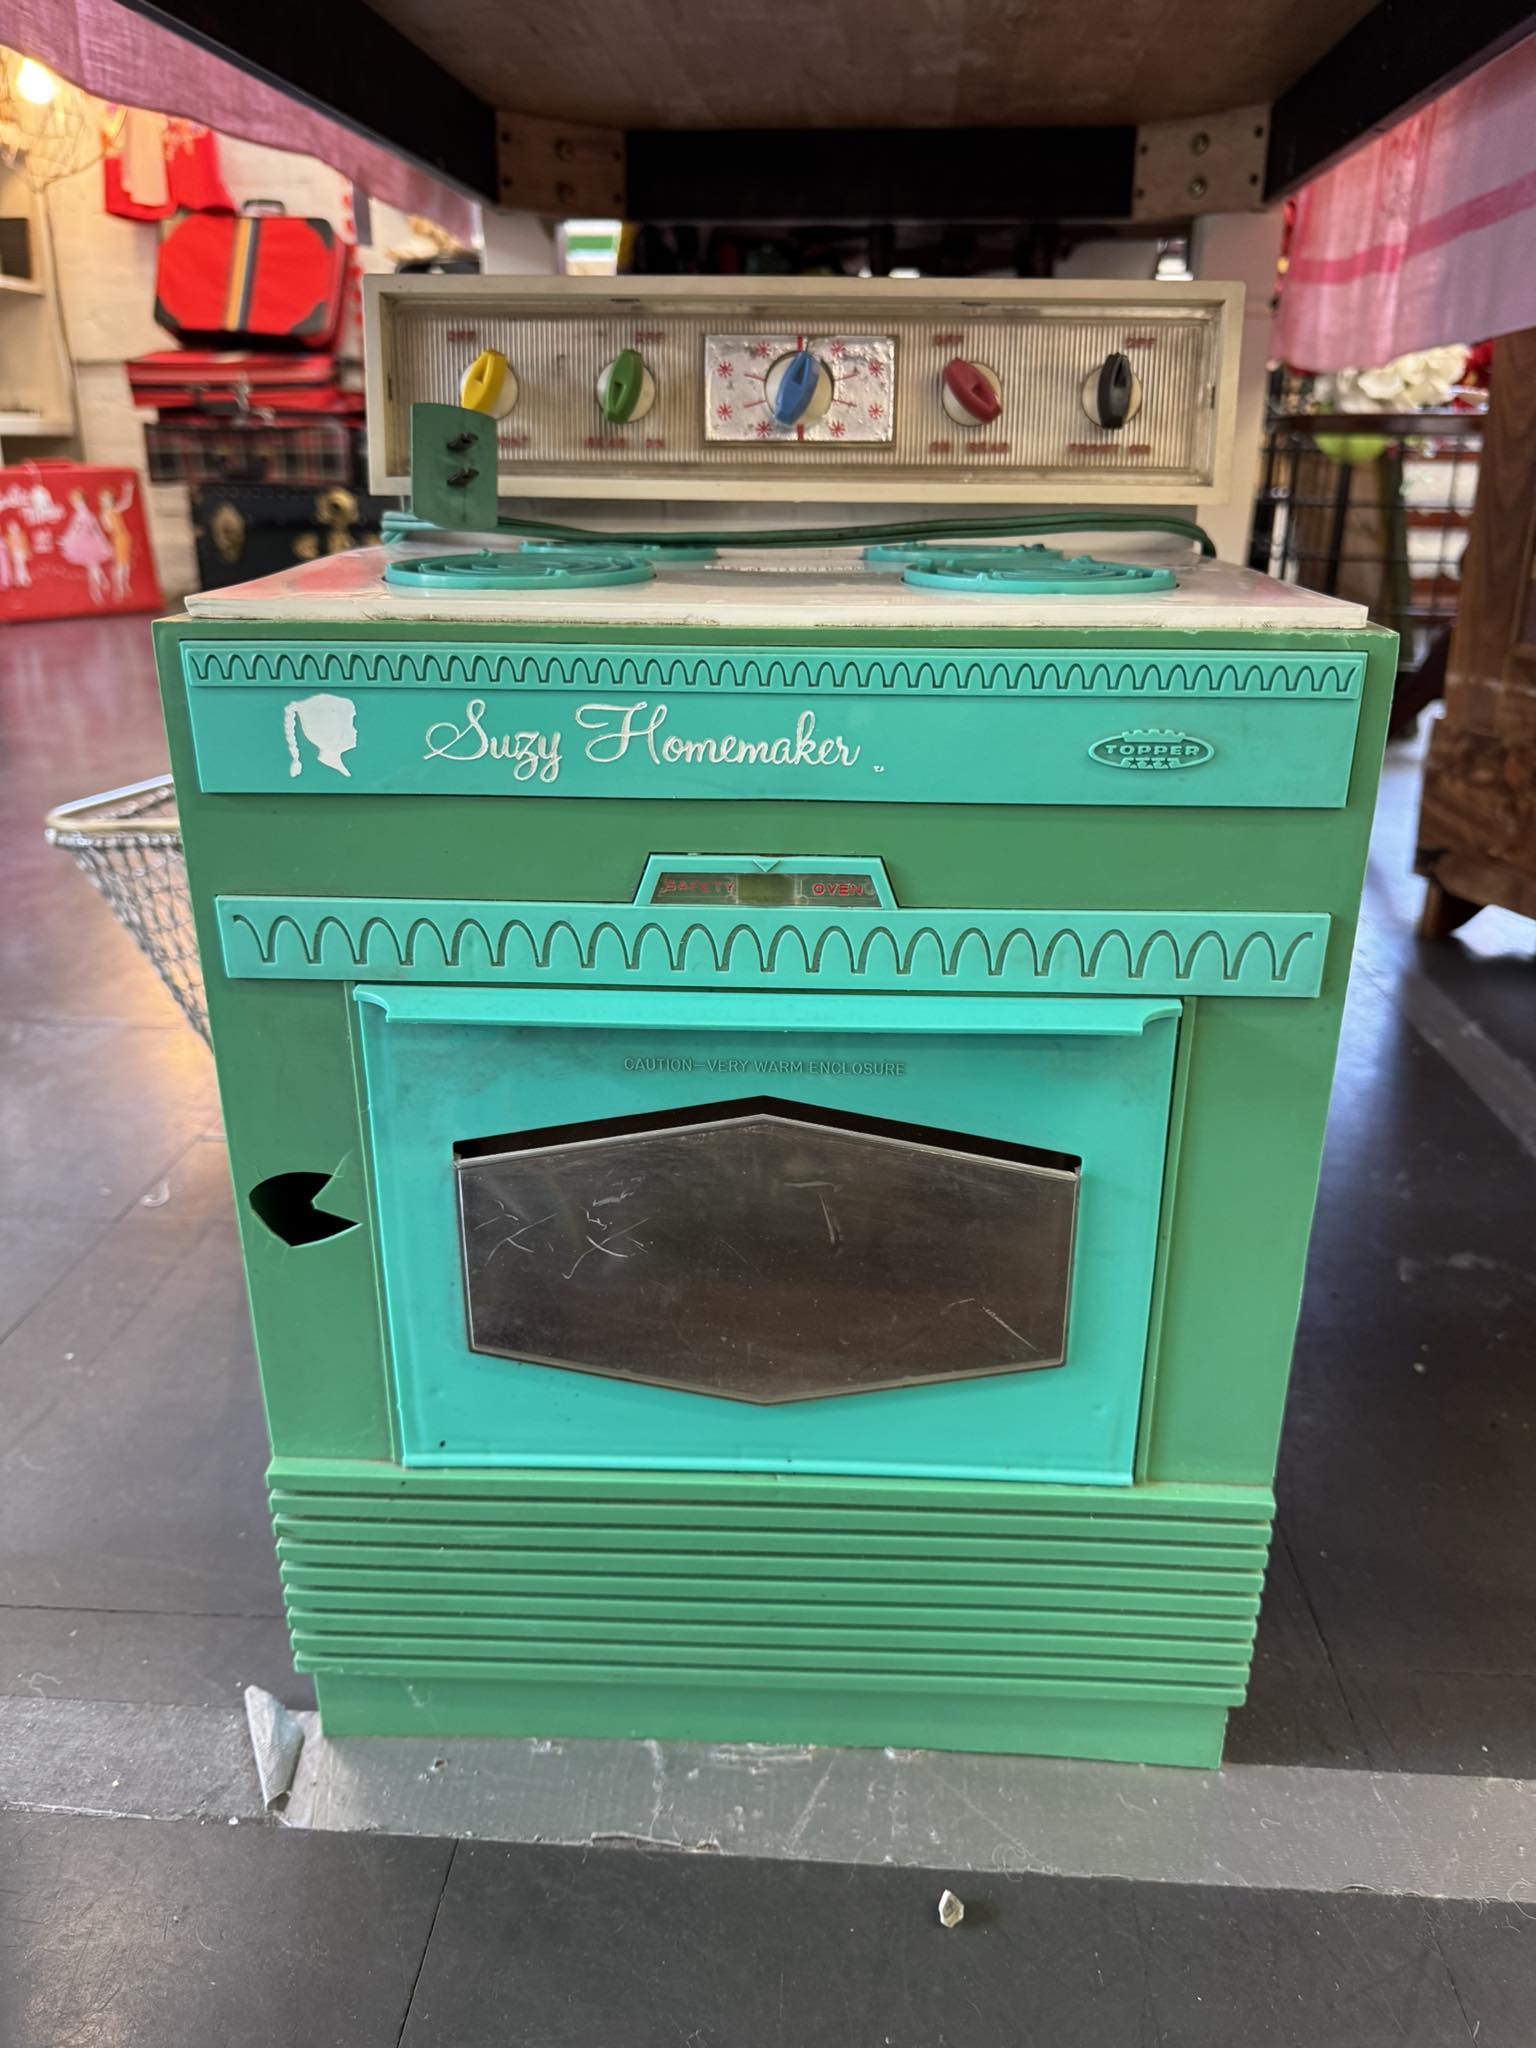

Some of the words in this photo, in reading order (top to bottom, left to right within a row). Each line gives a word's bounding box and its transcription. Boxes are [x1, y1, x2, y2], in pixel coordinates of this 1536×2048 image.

[424, 699, 562, 784] Suzy
[575, 701, 861, 766] Homemaker
[1105, 743, 1201, 757] TOPPER
[663, 879, 735, 893] SAFETY
[811, 882, 864, 897] OVEN
[754, 1059, 803, 1074] WARM
[808, 1060, 906, 1077] ENCLOSURE
